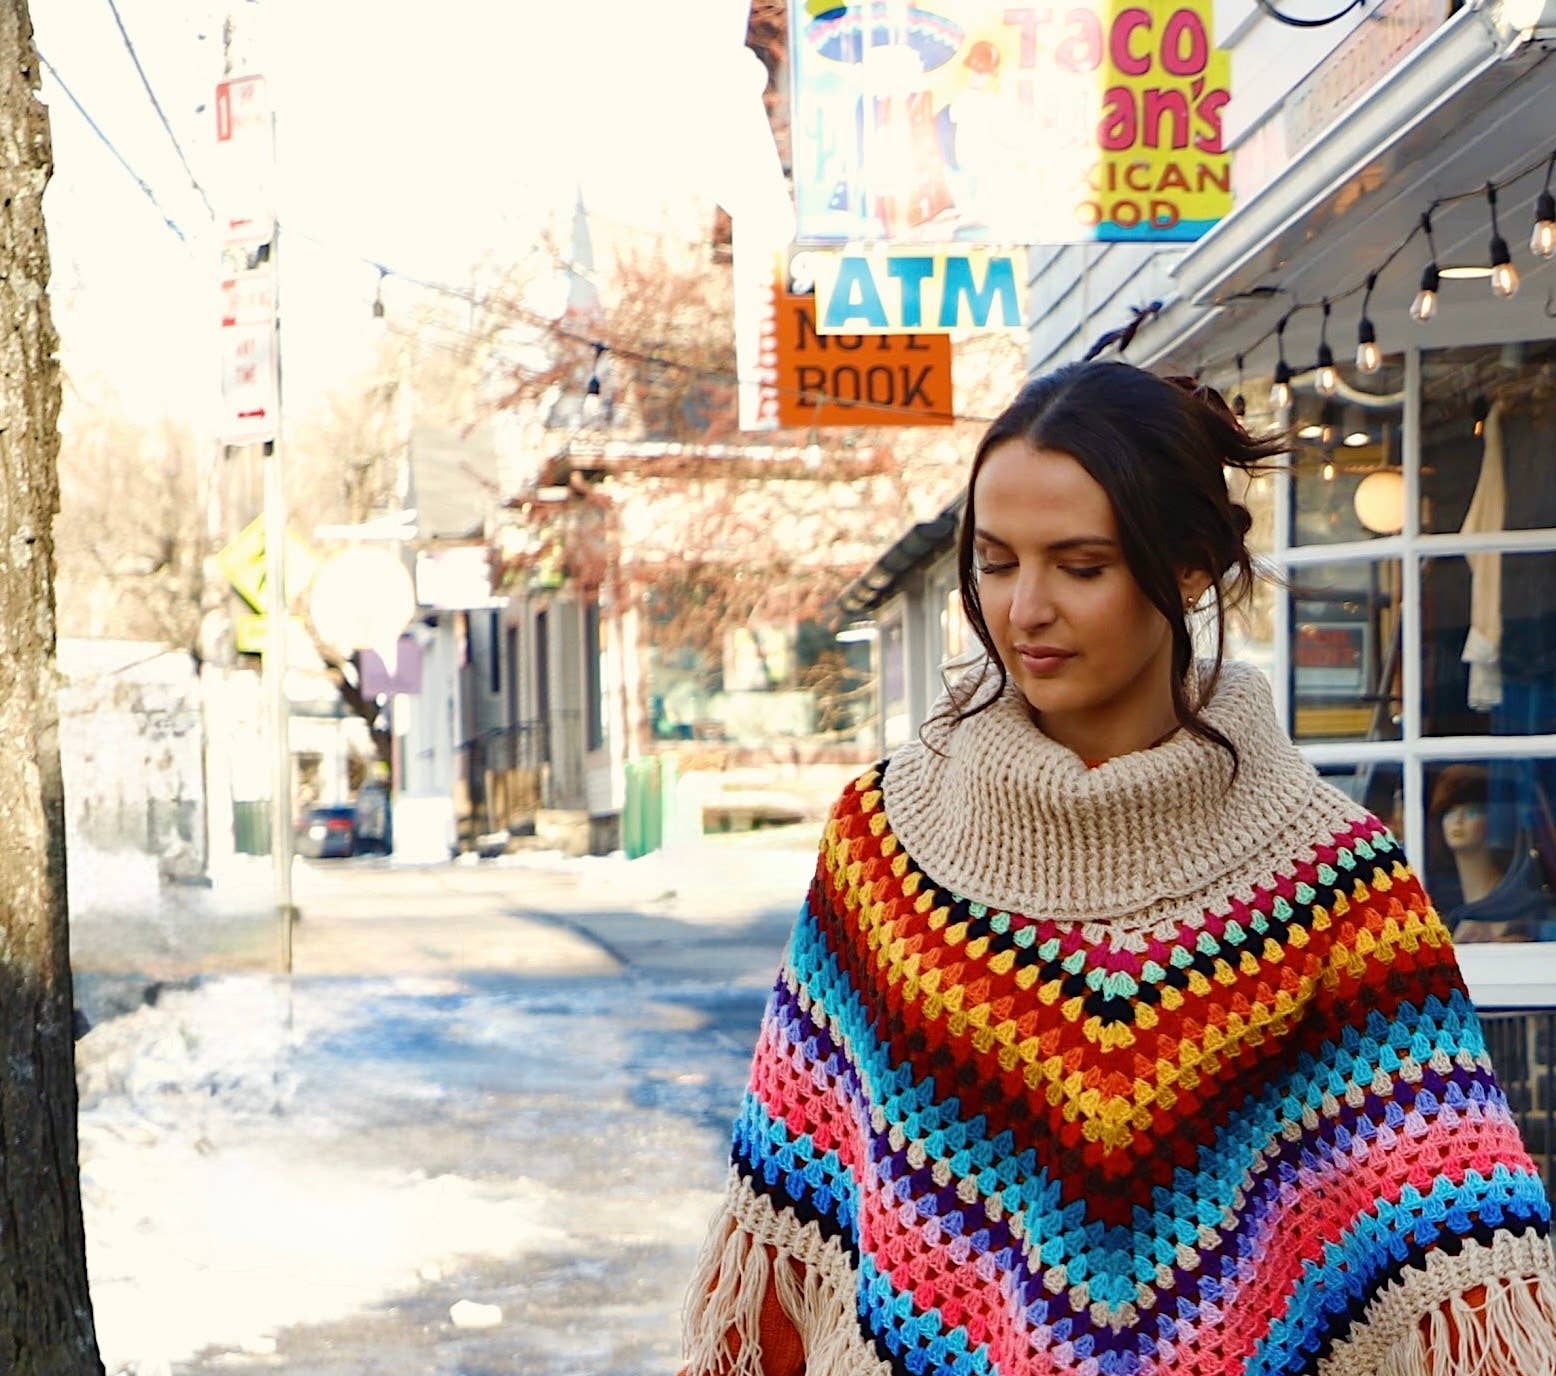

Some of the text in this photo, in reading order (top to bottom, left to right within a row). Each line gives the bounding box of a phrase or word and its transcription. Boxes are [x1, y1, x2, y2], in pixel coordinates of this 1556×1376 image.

[1003, 7, 1208, 76] Taco
[1074, 200, 1180, 229] OOD
[823, 256, 1022, 328] ATM
[794, 364, 935, 408] BOOK
